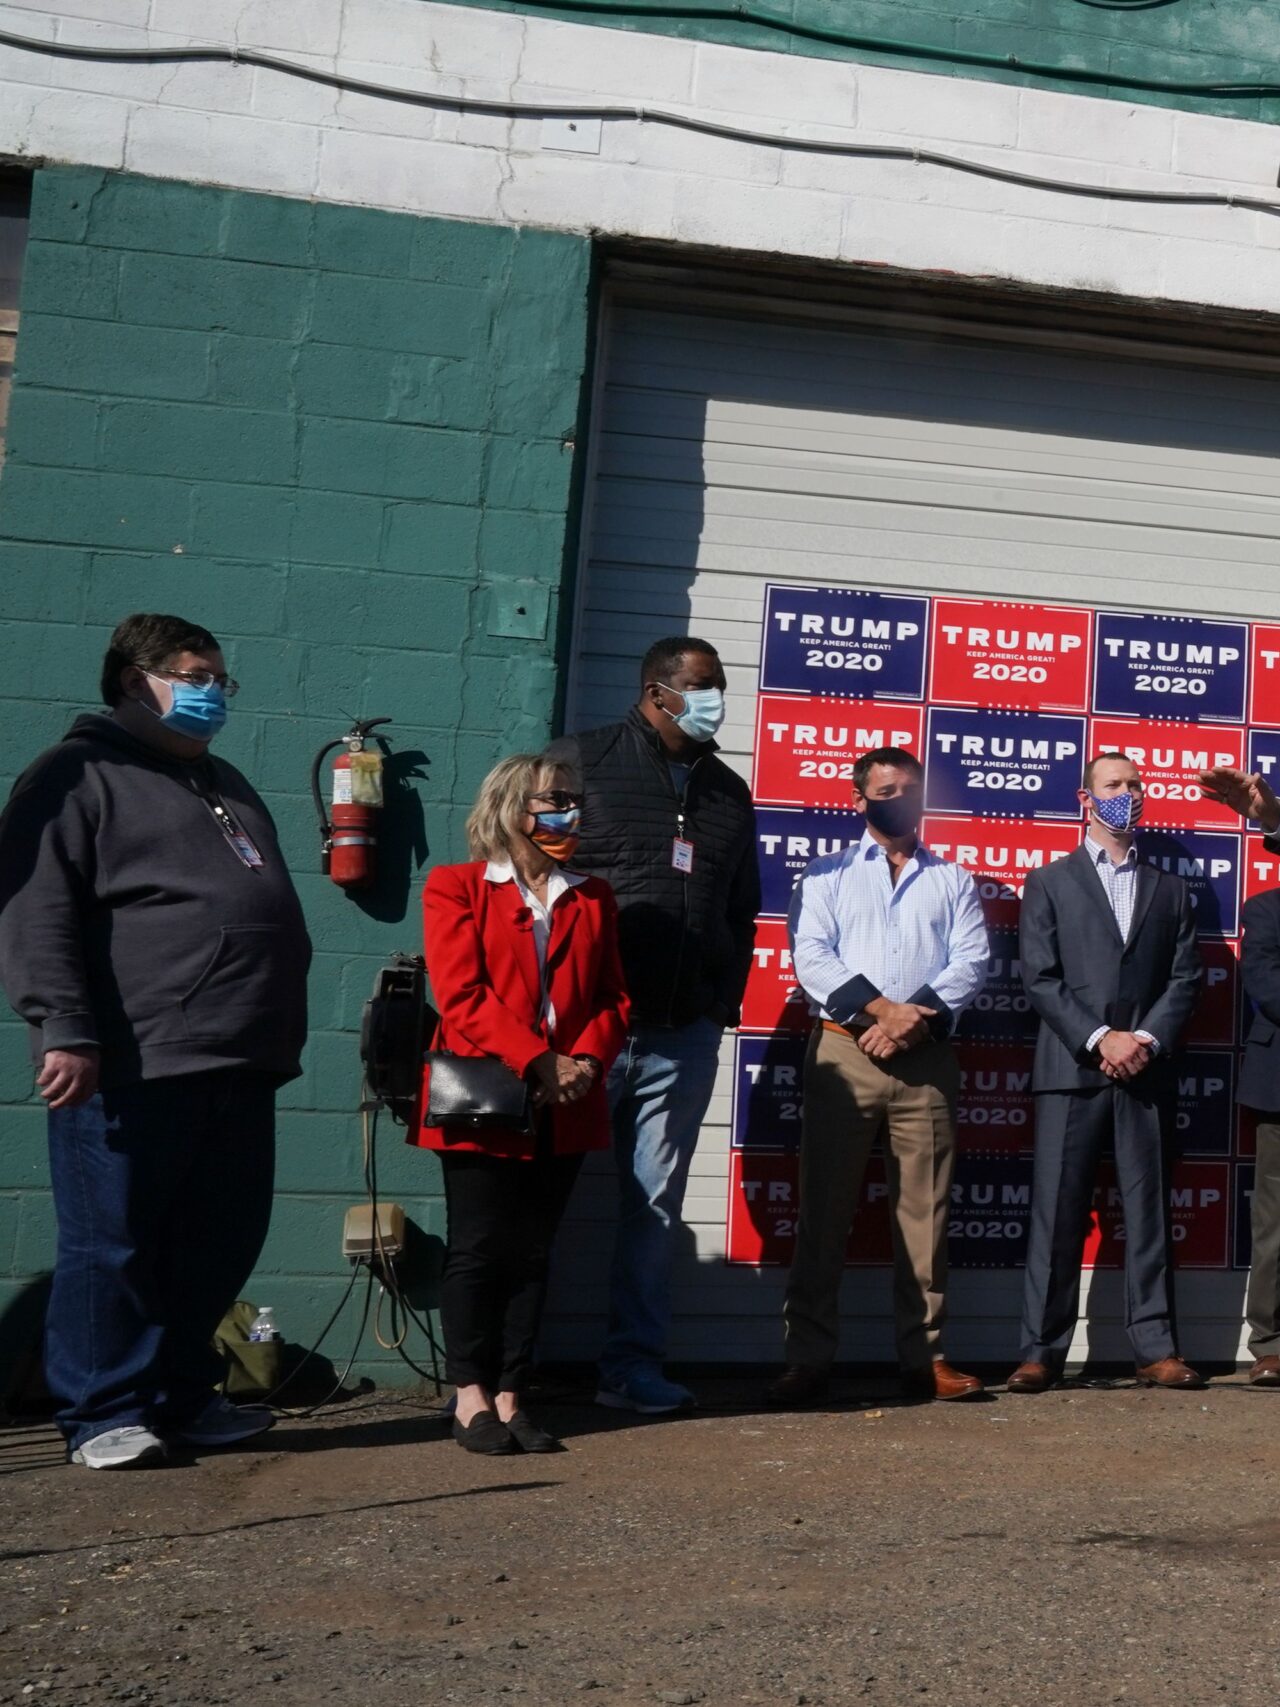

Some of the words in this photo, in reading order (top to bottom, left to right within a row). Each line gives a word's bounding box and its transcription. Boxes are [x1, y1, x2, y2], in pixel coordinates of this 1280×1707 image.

[775, 612, 918, 640] TRUMP
[823, 640, 860, 648] AMERICA
[862, 642, 892, 650] GREAT!
[942, 625, 1081, 653] TRUMP
[806, 650, 882, 671] 2020
[989, 652, 1024, 660] AMERICA
[1027, 655, 1055, 663] GREAT!
[1104, 638, 1239, 665] TRUMP
[973, 662, 1047, 683] 2020
[1150, 665, 1184, 673] AMERICA
[1135, 675, 1206, 695] 2020
[768, 722, 912, 748] TRUMP
[816, 750, 852, 758] AMERICA
[936, 734, 1076, 760] TRUMP
[799, 760, 854, 780] 202
[968, 771, 1042, 792] 2020
[760, 834, 860, 856] TRU
[1148, 856, 1232, 878] UMP
[979, 882, 1024, 900] 02
[957, 1107, 1027, 1126] 2020
[951, 1184, 1030, 1204] RUM
[947, 1220, 1024, 1238] 2020
